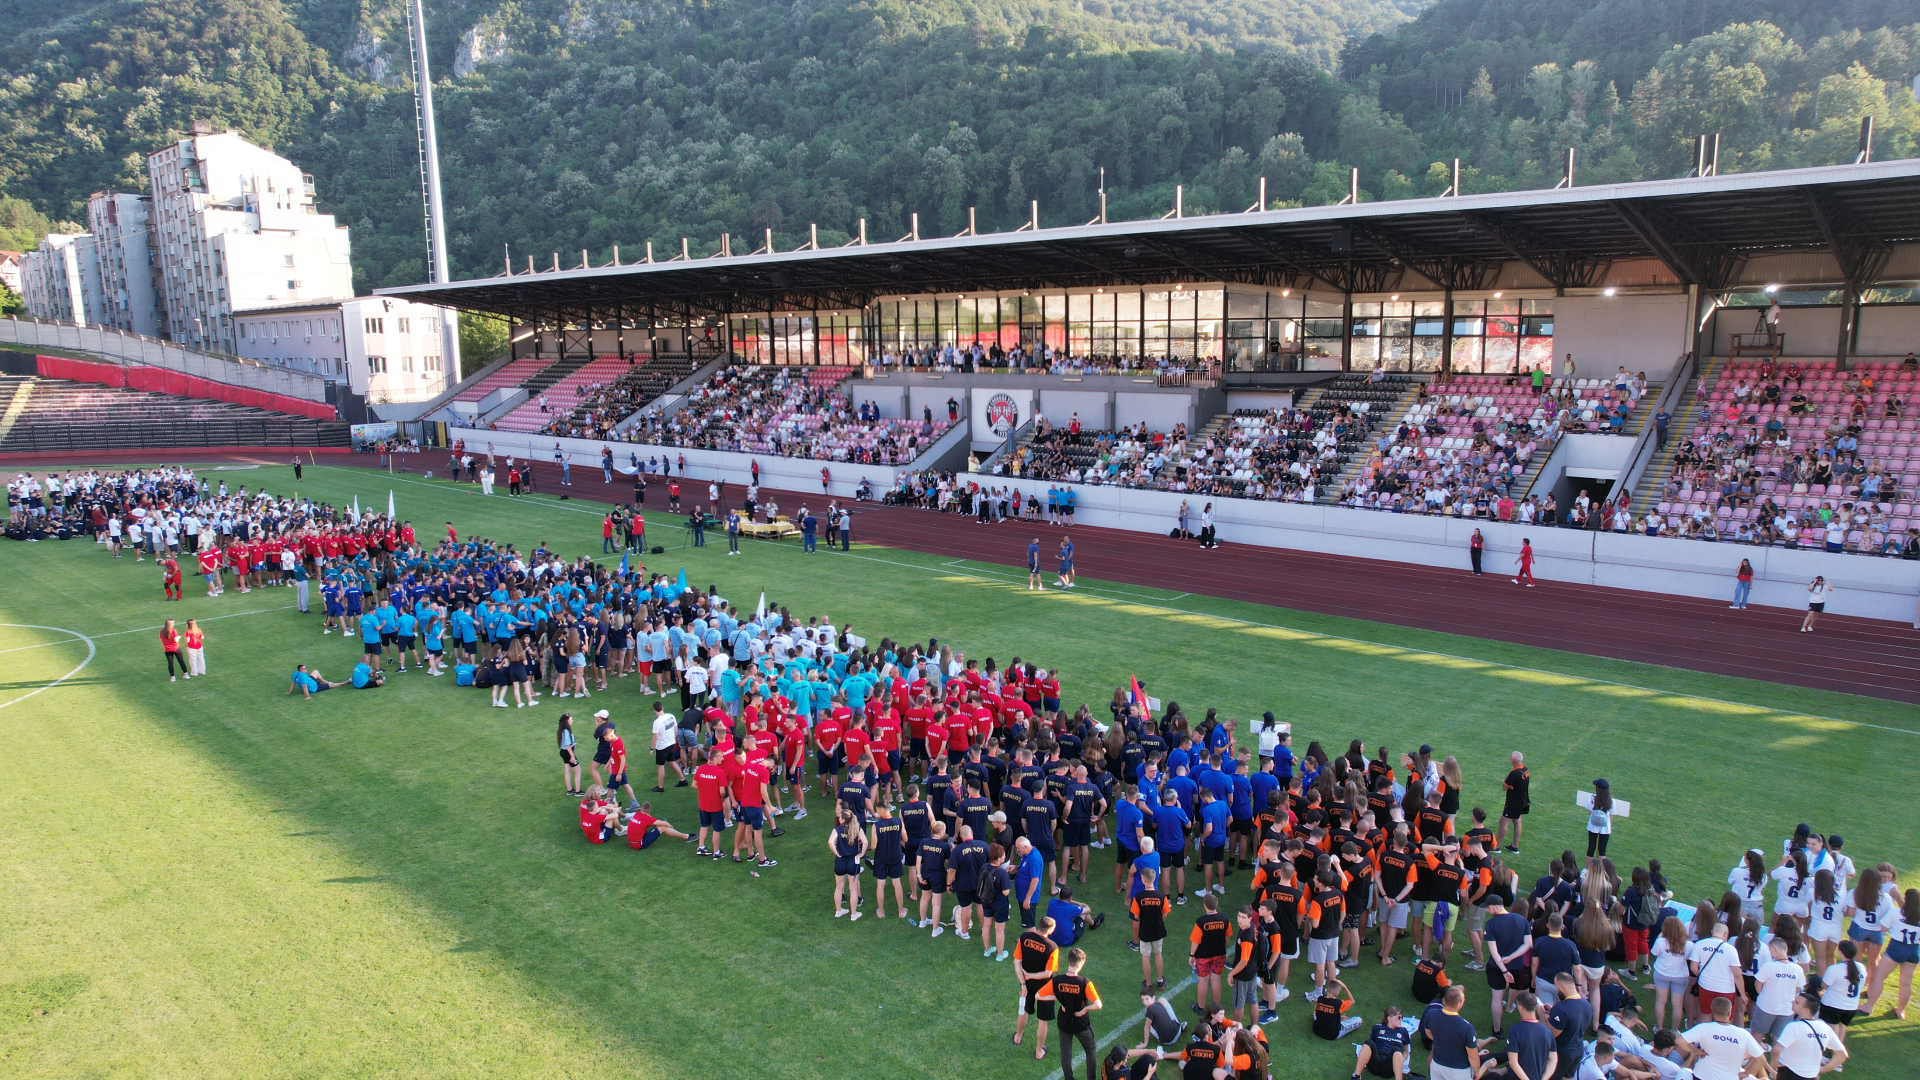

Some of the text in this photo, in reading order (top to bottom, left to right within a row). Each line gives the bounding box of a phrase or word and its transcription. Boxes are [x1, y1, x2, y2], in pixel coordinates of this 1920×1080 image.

[1747, 885, 1755, 898] 7
[1788, 886, 1798, 898] 6
[1823, 906, 1833, 920] 8
[1865, 911, 1876, 923] 5
[1900, 929, 1917, 944] 11
[1847, 984, 1858, 998] 9
[1712, 1034, 1738, 1044] ФОЧА
